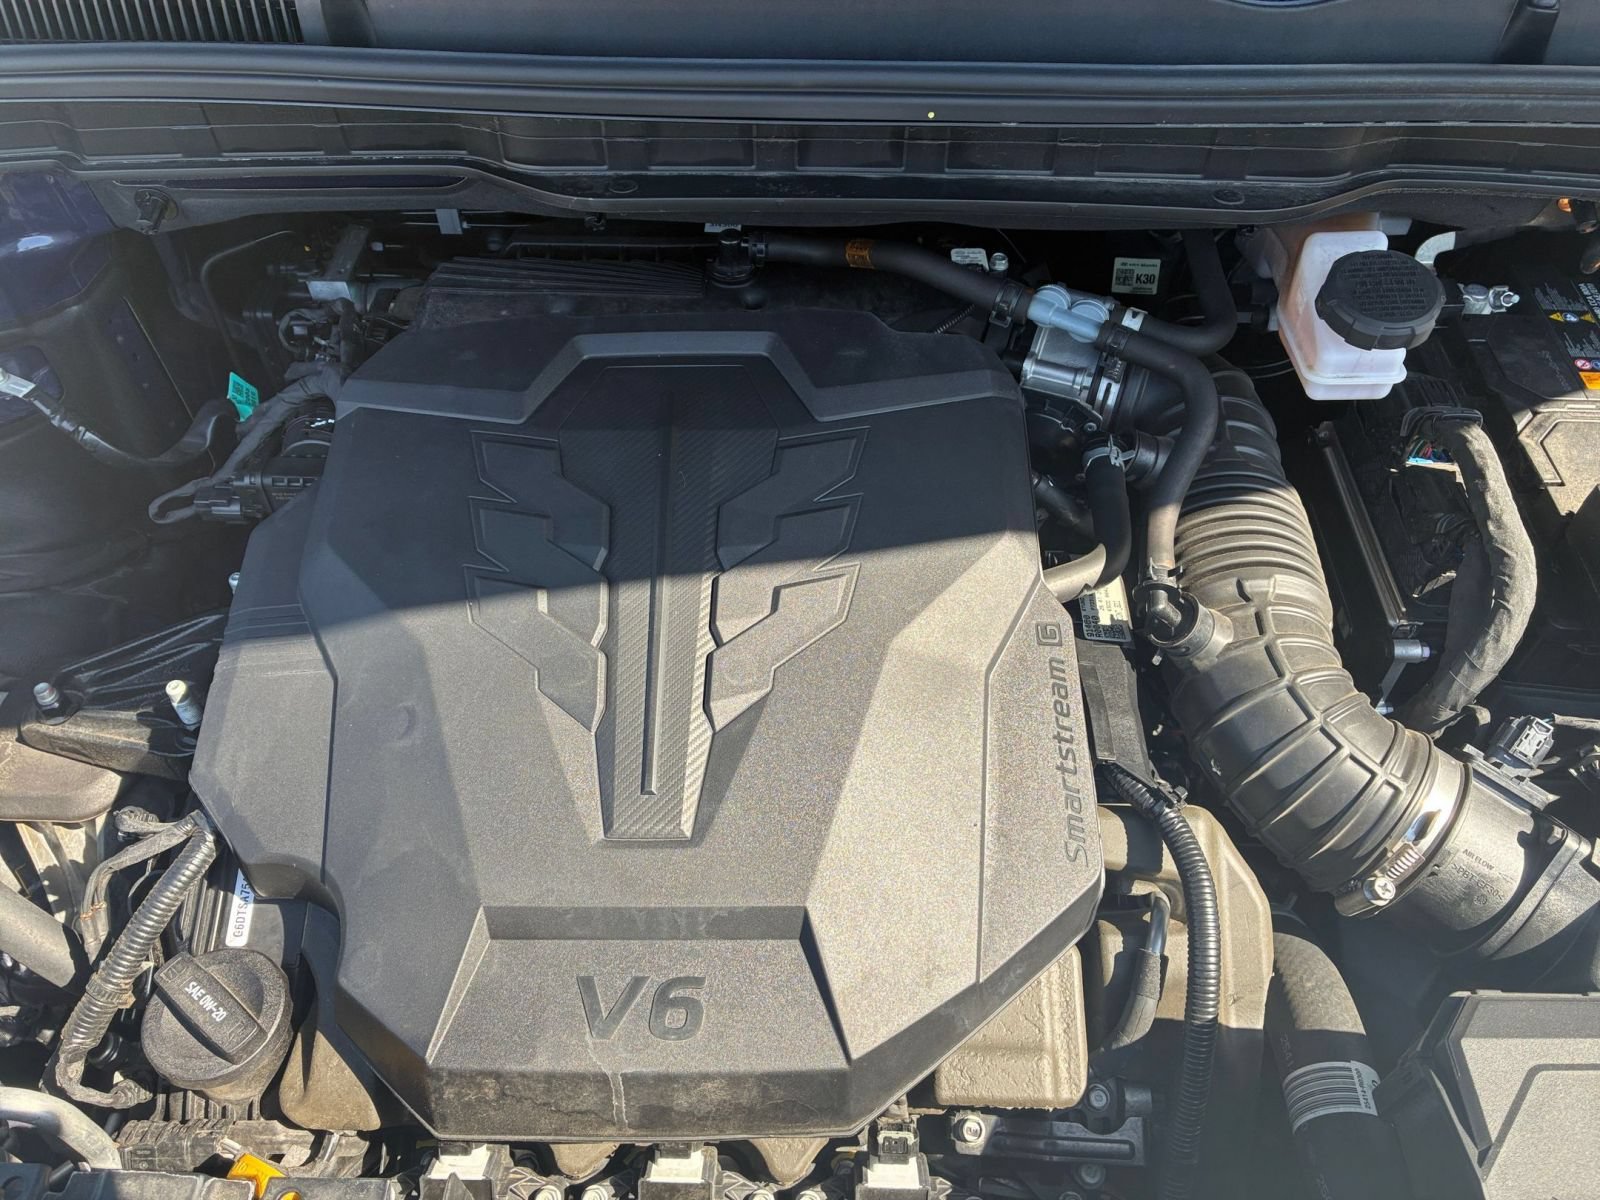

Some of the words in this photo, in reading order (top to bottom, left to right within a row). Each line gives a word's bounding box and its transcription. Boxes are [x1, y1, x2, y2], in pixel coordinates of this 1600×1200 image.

[1135, 273, 1156, 285] K30
[1050, 656, 1090, 868] Smartstream
[184, 980, 203, 1002] SAE
[199, 995, 228, 1023] 0W-20
[576, 975, 706, 1041] V6
